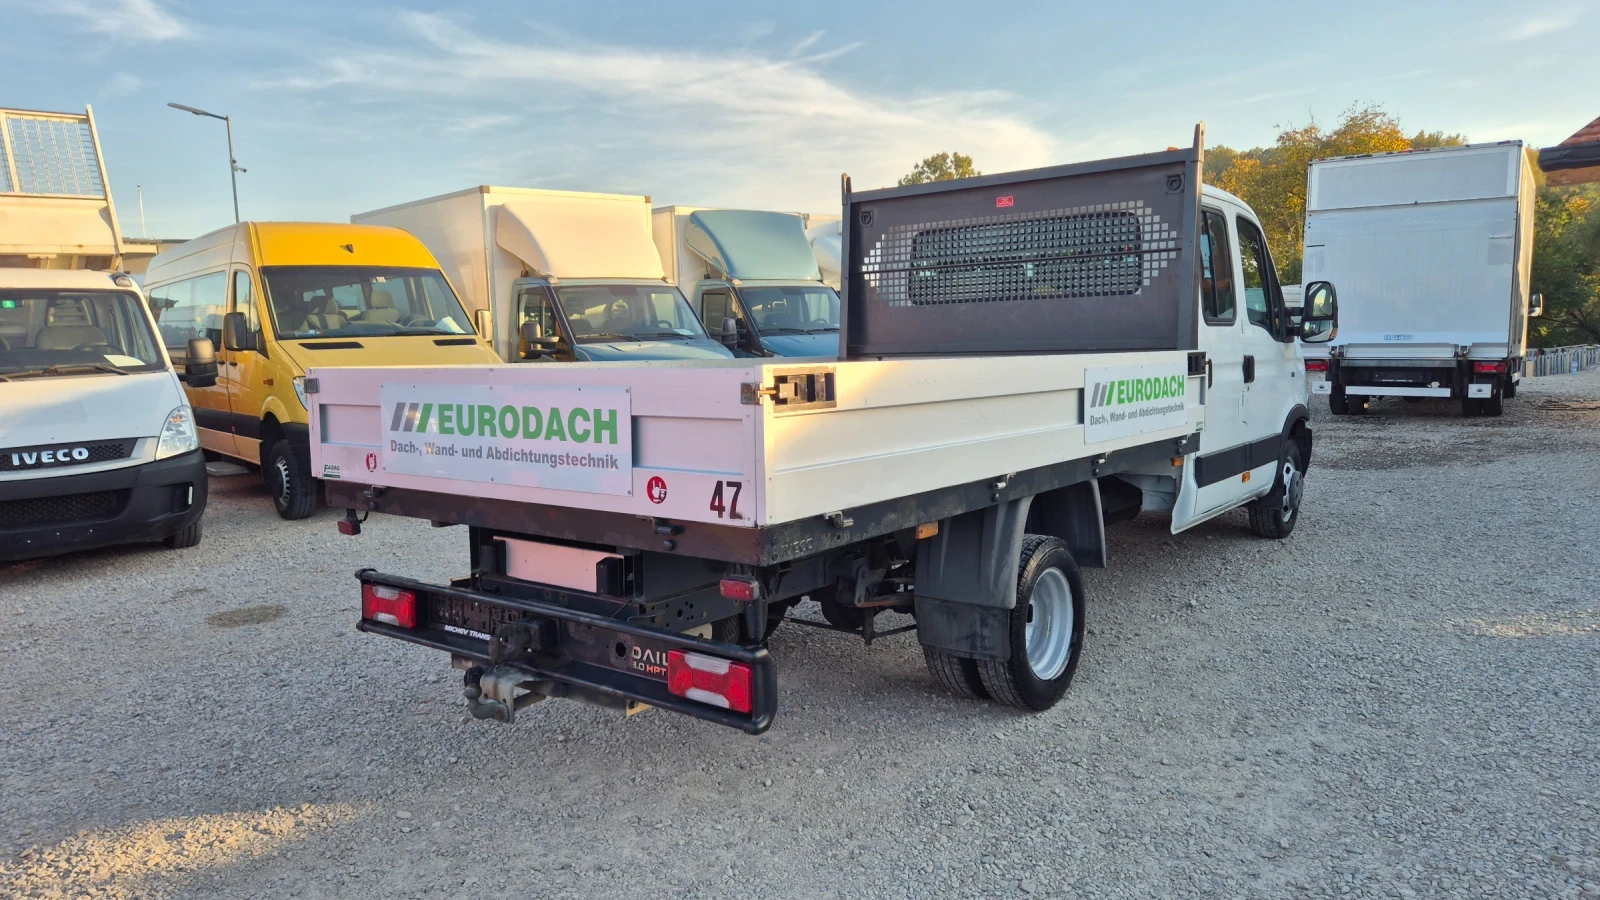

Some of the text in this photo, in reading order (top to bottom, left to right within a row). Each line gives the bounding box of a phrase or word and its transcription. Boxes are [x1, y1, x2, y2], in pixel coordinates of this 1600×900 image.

[1117, 375, 1185, 404] EURODACH
[1110, 411, 1127, 422] Wand-
[1128, 409, 1138, 419] und
[1138, 402, 1185, 417] Abdichtungstechnik
[437, 403, 618, 445] EURODACH
[11, 447, 89, 466] IVECO
[390, 440, 619, 469] Dach-, Wand- und Abdichtungstechnik
[469, 630, 491, 641] TRANS
[632, 645, 668, 666] DAIL
[646, 664, 667, 676] HPT
